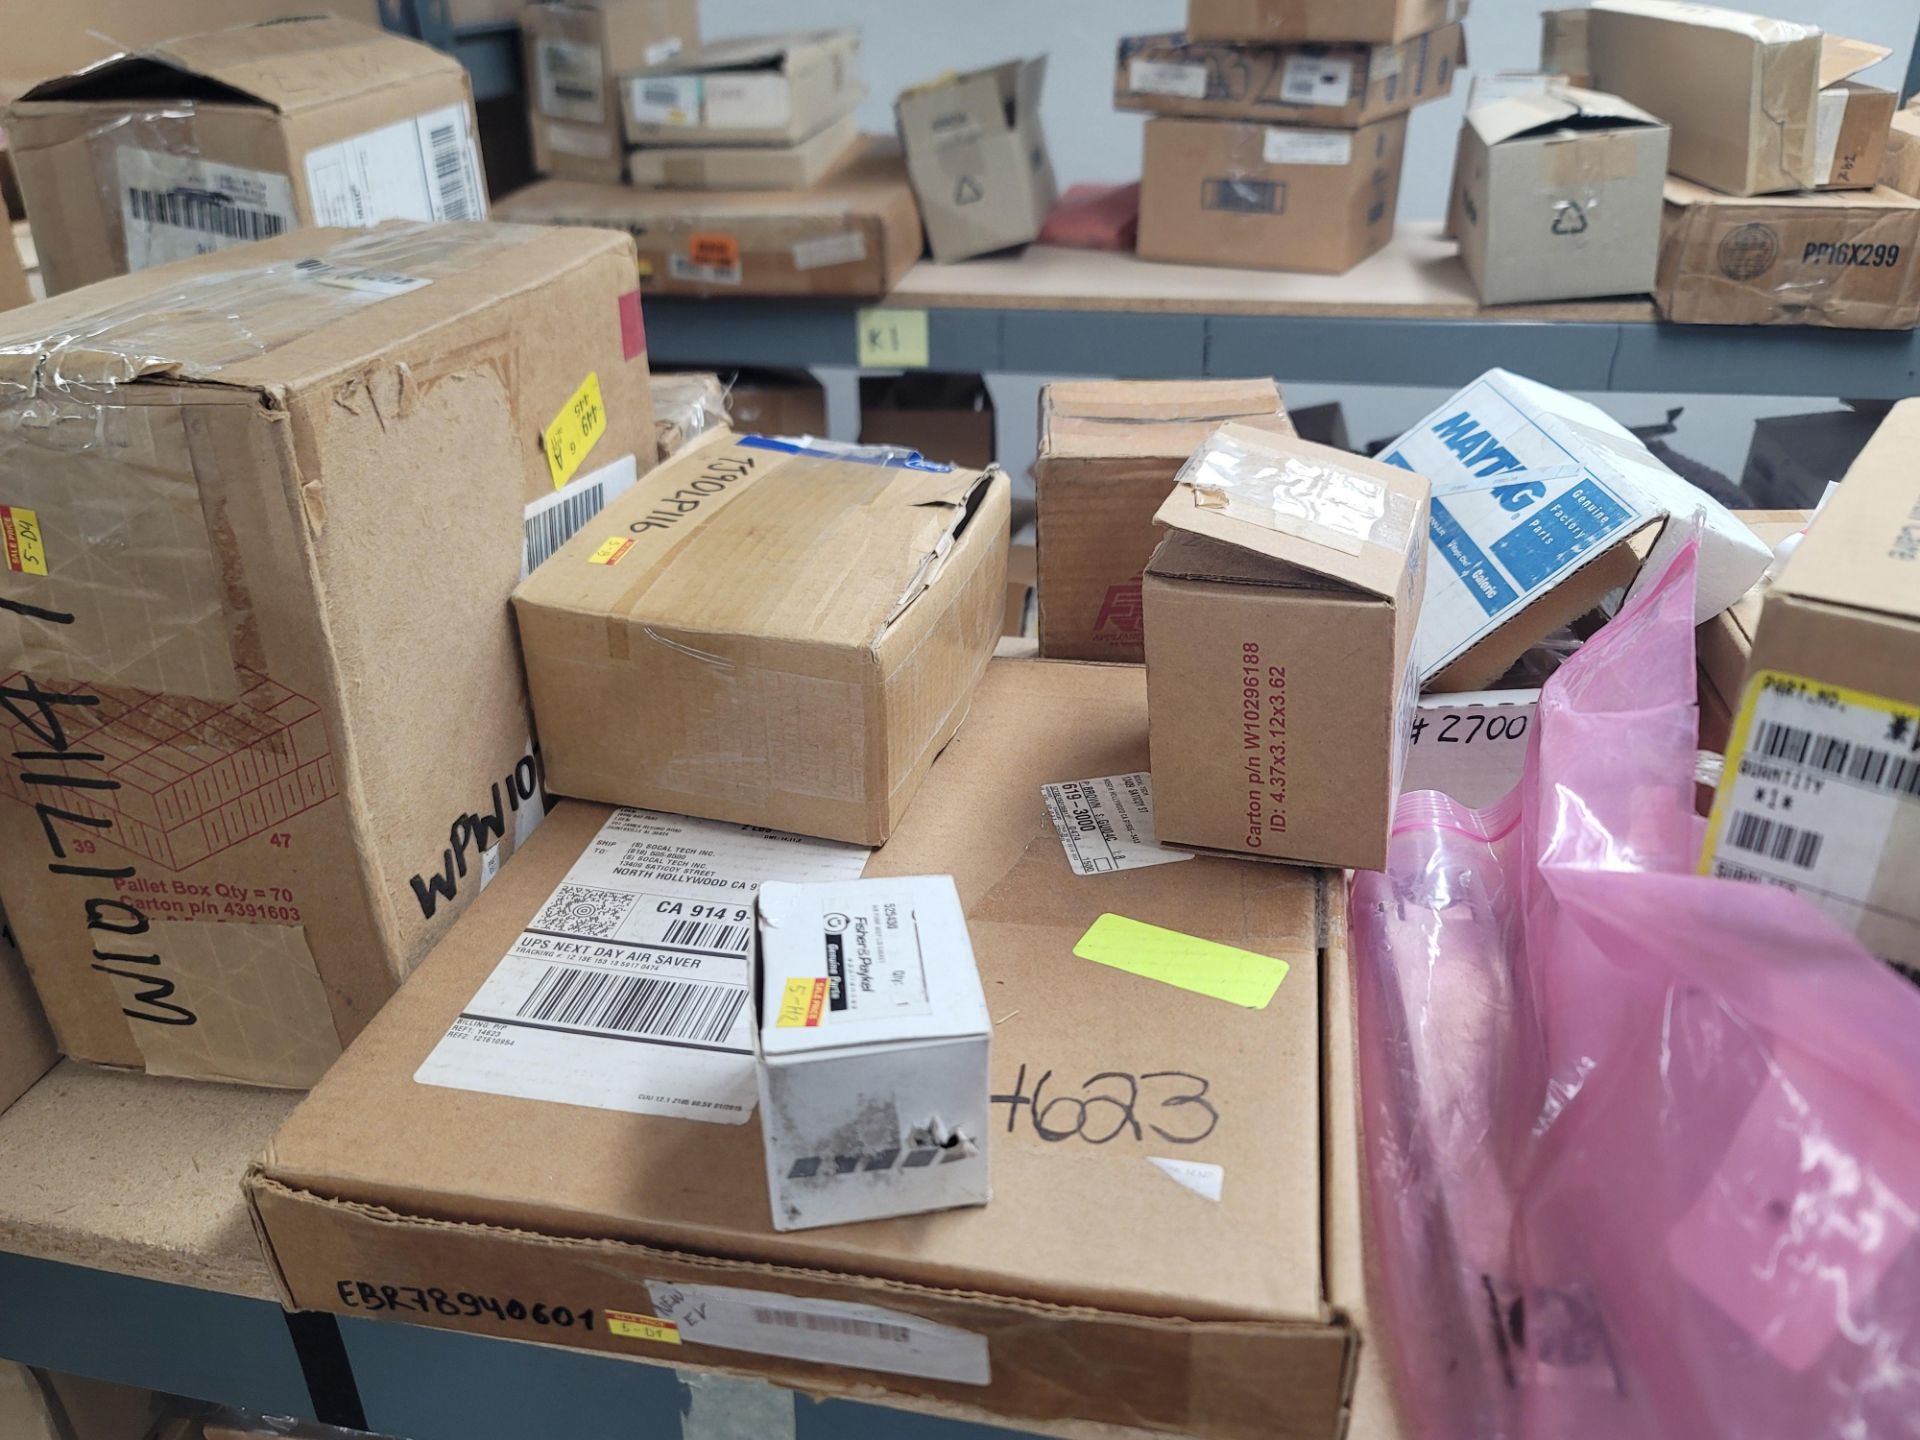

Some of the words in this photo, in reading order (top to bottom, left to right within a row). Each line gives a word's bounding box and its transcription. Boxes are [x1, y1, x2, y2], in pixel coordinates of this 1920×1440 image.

[1571, 488, 1611, 524] Genuine
[1529, 519, 1555, 546] Parts
[1549, 502, 1587, 541] Factory
[8, 541, 21, 565] SALE
[1471, 568, 1500, 600] Caloric
[1243, 641, 1260, 750] W10296188
[1269, 666, 1286, 803] 4.37x3.12x3.62
[1245, 756, 1265, 784] p/n
[1740, 759, 1824, 795] QUANTITY
[1062, 783, 1096, 832] 619-3000
[1246, 790, 1262, 848] Carton
[1270, 808, 1286, 833] ID:
[73, 839, 97, 853] 39
[270, 833, 292, 849] 47
[410, 754, 537, 920] WPW10
[596, 840, 617, 848] SHIP
[645, 843, 673, 853] SOCAL
[675, 846, 696, 856] TECH
[698, 848, 716, 857] INC.
[637, 855, 664, 865] SOCAL
[666, 858, 689, 867] TECH
[690, 861, 708, 870] INC.
[644, 863, 681, 873] SATICOY
[682, 867, 717, 877] STREET
[113, 877, 168, 894] Pallet
[173, 881, 211, 895] Box
[215, 882, 248, 901] Qty
[270, 888, 293, 902] 70
[612, 867, 651, 879] NORTH
[655, 871, 728, 887] HOLLYWOOD
[730, 880, 746, 890] CA
[119, 895, 184, 912] Carton
[189, 902, 219, 917] p/n
[224, 902, 301, 921] 4391603
[656, 900, 683, 915] CA
[690, 905, 727, 920] 914
[516, 947, 554, 958] TRACKING
[521, 936, 551, 949] UPS
[553, 941, 592, 954] NEXT
[594, 946, 625, 960] DAY
[626, 951, 651, 963] AIR
[654, 955, 702, 969] SAVER
[827, 943, 840, 975] Genuine
[337, 1279, 595, 1331] EBR78940601
